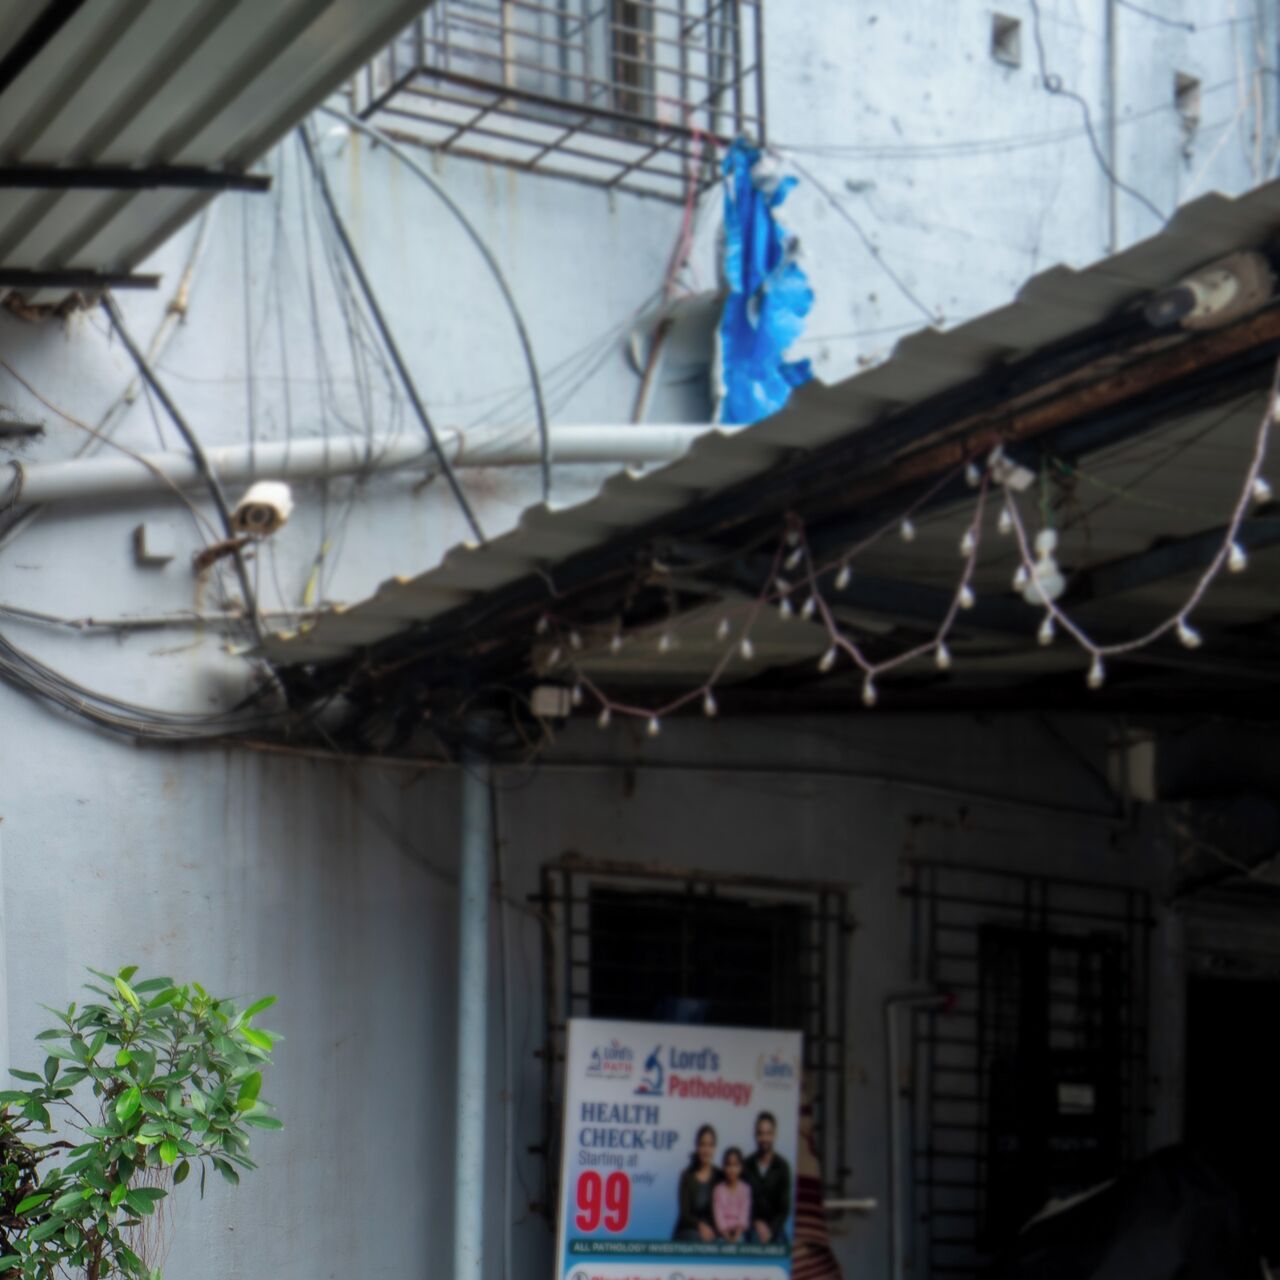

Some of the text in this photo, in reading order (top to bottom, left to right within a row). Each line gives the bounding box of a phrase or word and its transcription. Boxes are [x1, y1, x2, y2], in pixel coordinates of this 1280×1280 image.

[669, 1047, 720, 1071] Lord's
[668, 1075, 753, 1106] Pathology
[580, 1103, 659, 1124] HEALTH
[579, 1127, 679, 1150] CHECK-UP
[578, 1151, 637, 1170] Starting at
[575, 1170, 630, 1232] 99
[574, 1242, 590, 1252] ALL
[593, 1243, 646, 1253] PATHOLOGY
